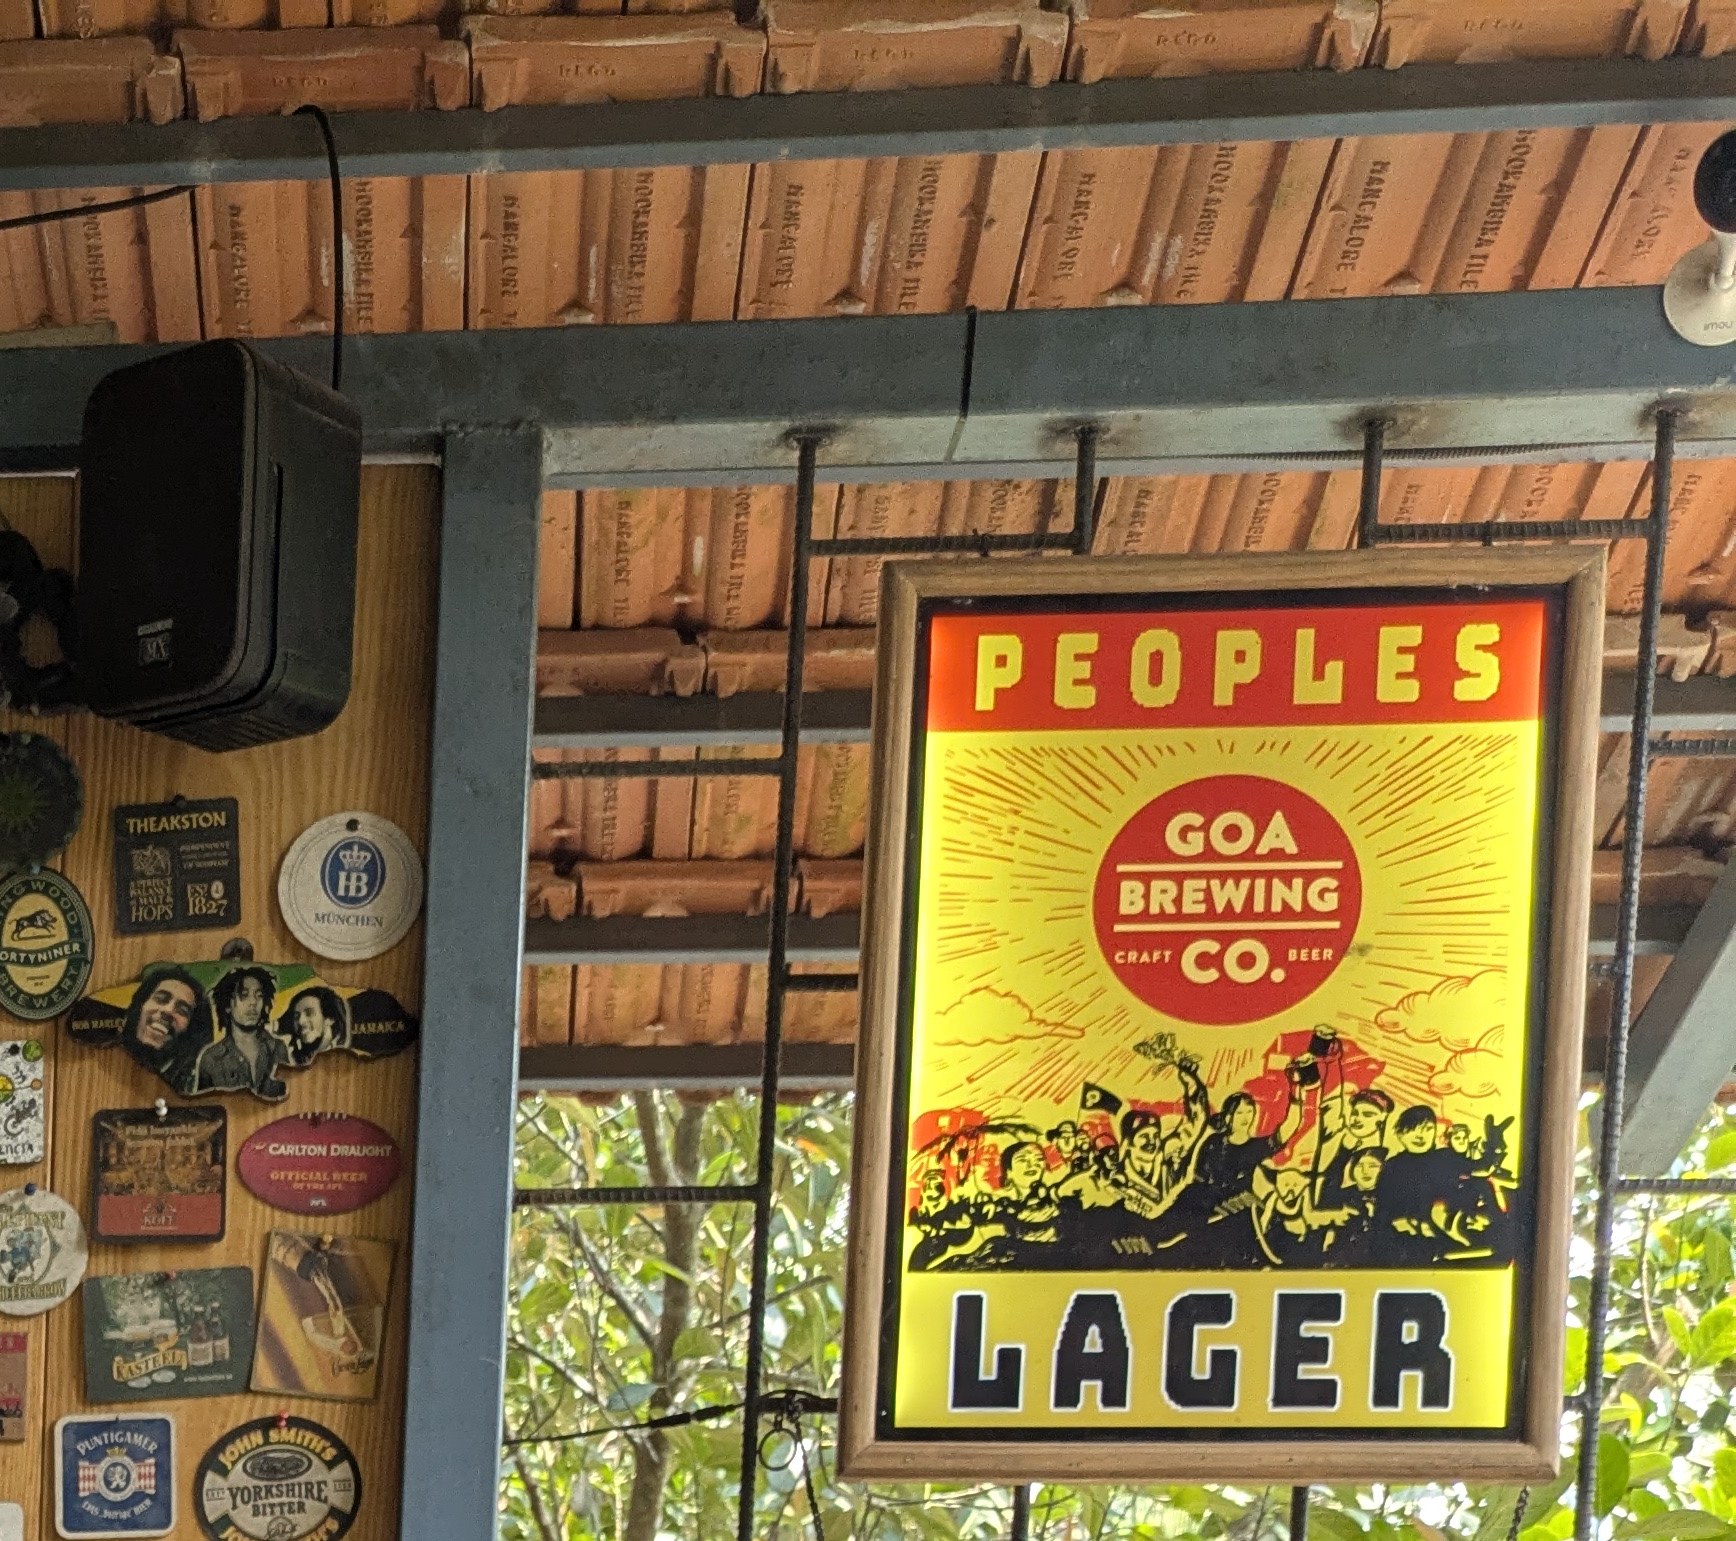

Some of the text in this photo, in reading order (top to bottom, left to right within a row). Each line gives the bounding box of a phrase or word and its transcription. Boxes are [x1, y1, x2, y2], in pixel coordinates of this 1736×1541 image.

[974, 623, 1501, 713] PEOPLES
[127, 812, 226, 834] THEAKSTON
[1165, 812, 1298, 857] GOA
[1118, 876, 1340, 917] BREWING
[1114, 938, 1334, 984] CRAFT CO. BEER
[268, 1143, 392, 1156] CARLTON DRAUGHT
[948, 1290, 1454, 1415] LAGER
[76, 1431, 158, 1456] PUNTIGAMER
[227, 1480, 328, 1511] YORKSHIRE
[252, 1501, 306, 1517] BITTER
